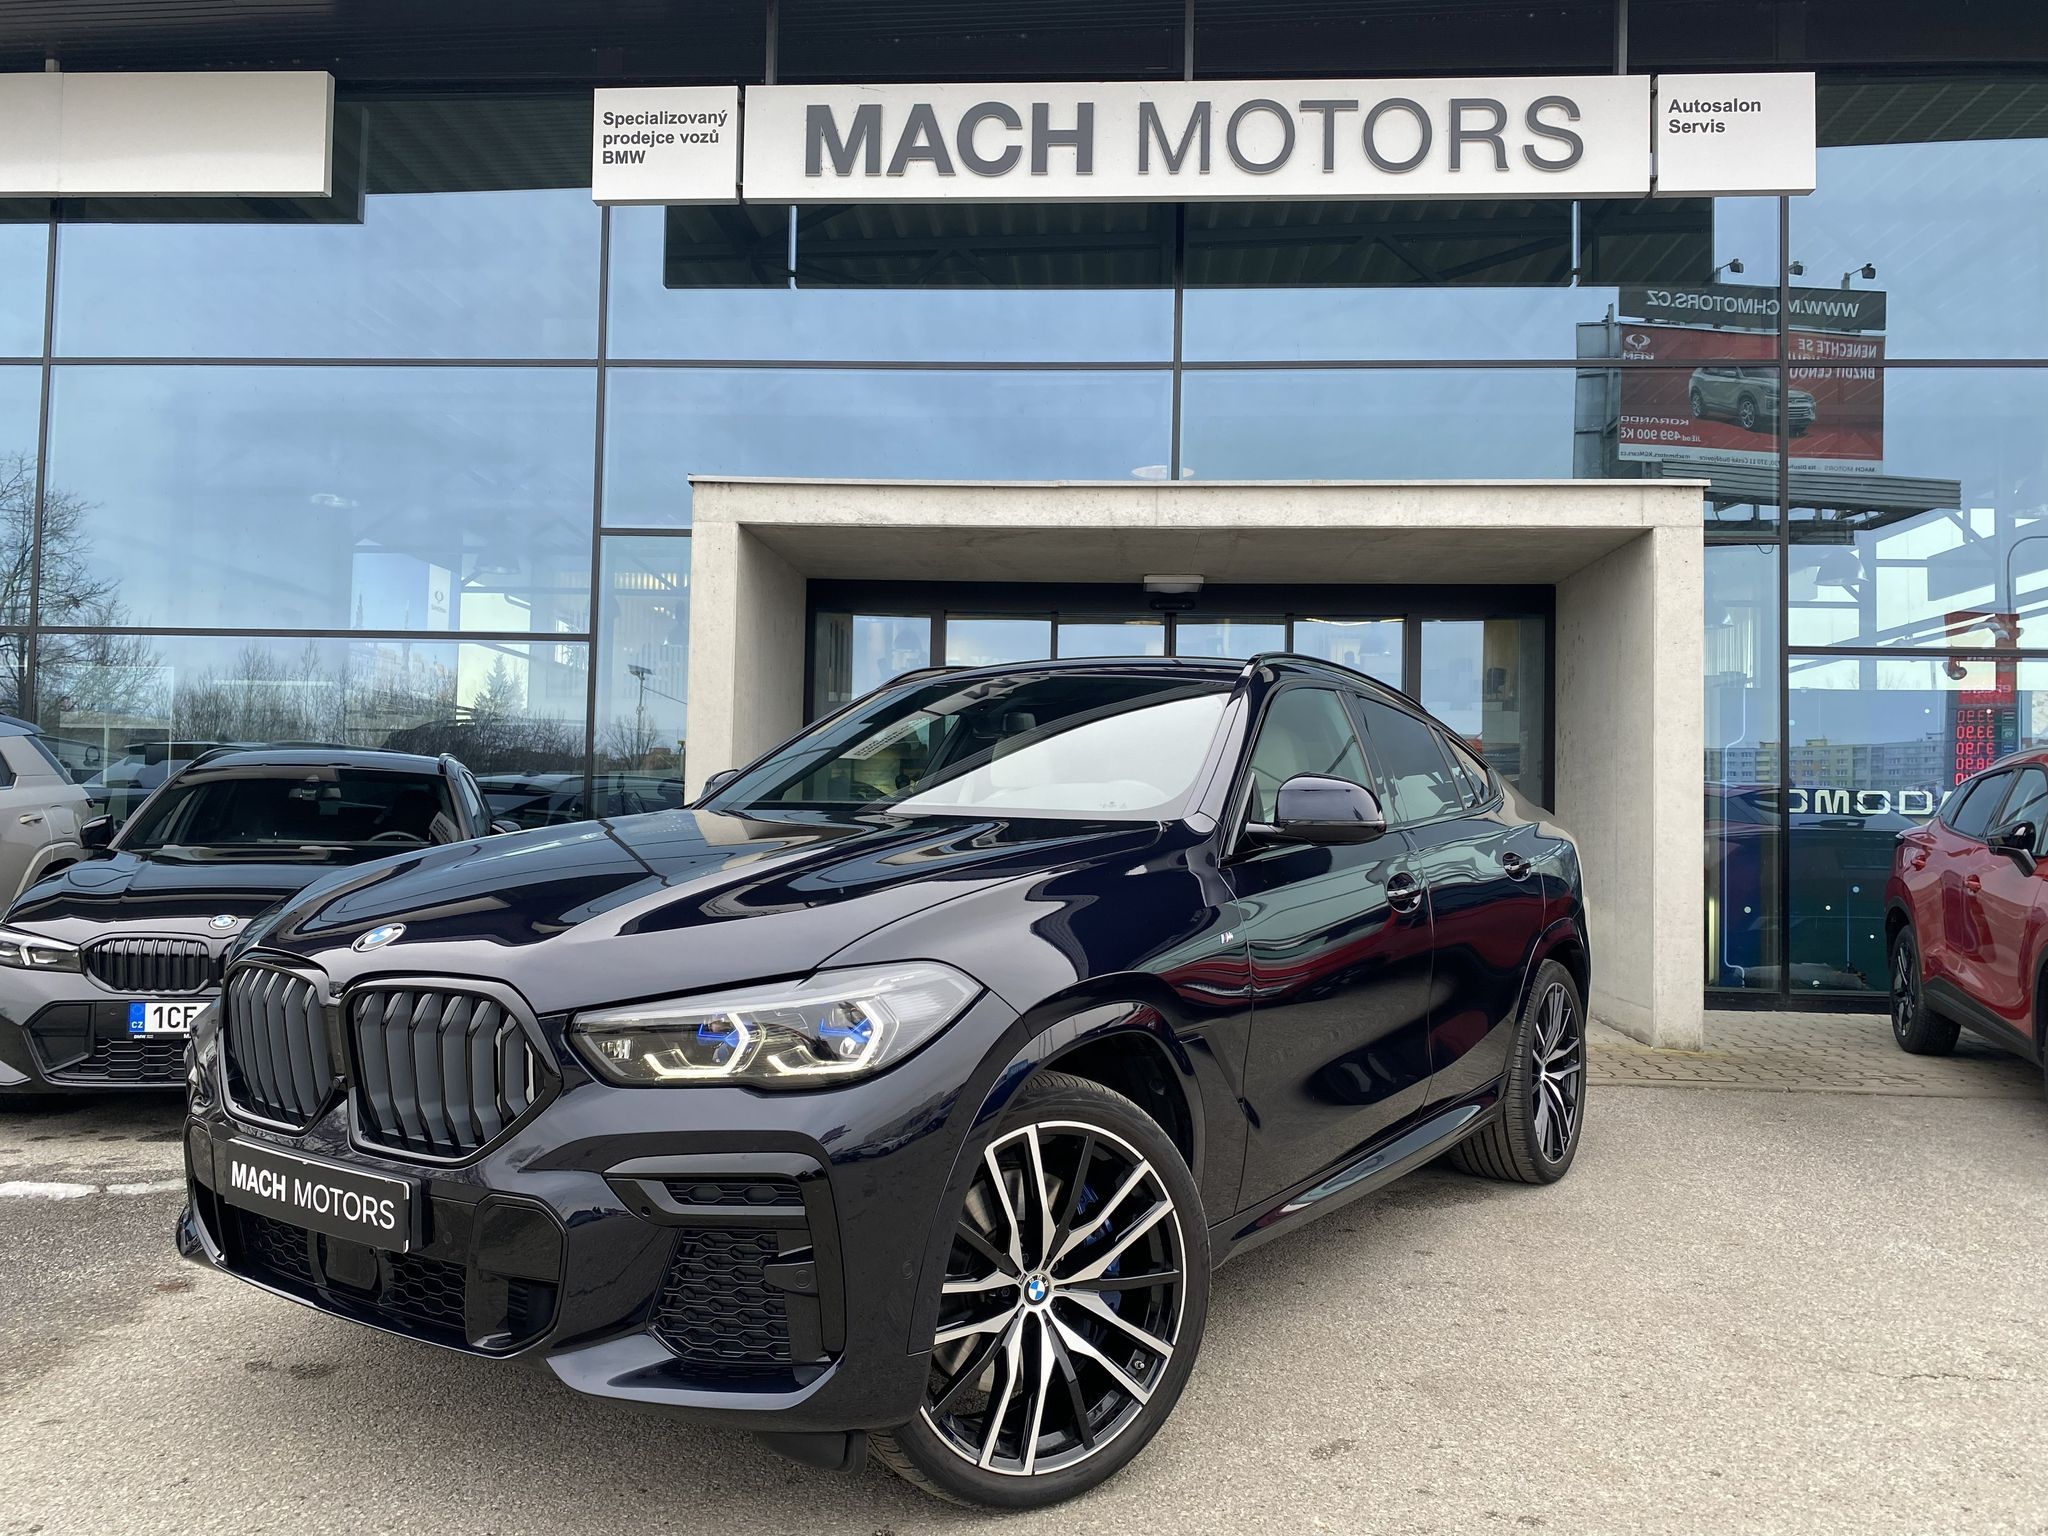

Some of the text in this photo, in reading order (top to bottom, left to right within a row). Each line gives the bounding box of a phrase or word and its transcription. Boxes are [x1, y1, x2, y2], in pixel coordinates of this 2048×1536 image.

[1668, 97, 1762, 114] Autosalon
[602, 109, 728, 129] Specializovaný
[1668, 118, 1726, 134] Servis
[602, 129, 719, 148] prodejce vozů
[804, 95, 1585, 178] MACH MOTORS
[602, 150, 646, 164] BMW
[1788, 789, 1952, 815] OMOD
[131, 1020, 144, 1029] CZ
[231, 1160, 396, 1230] MACH MOTORS
